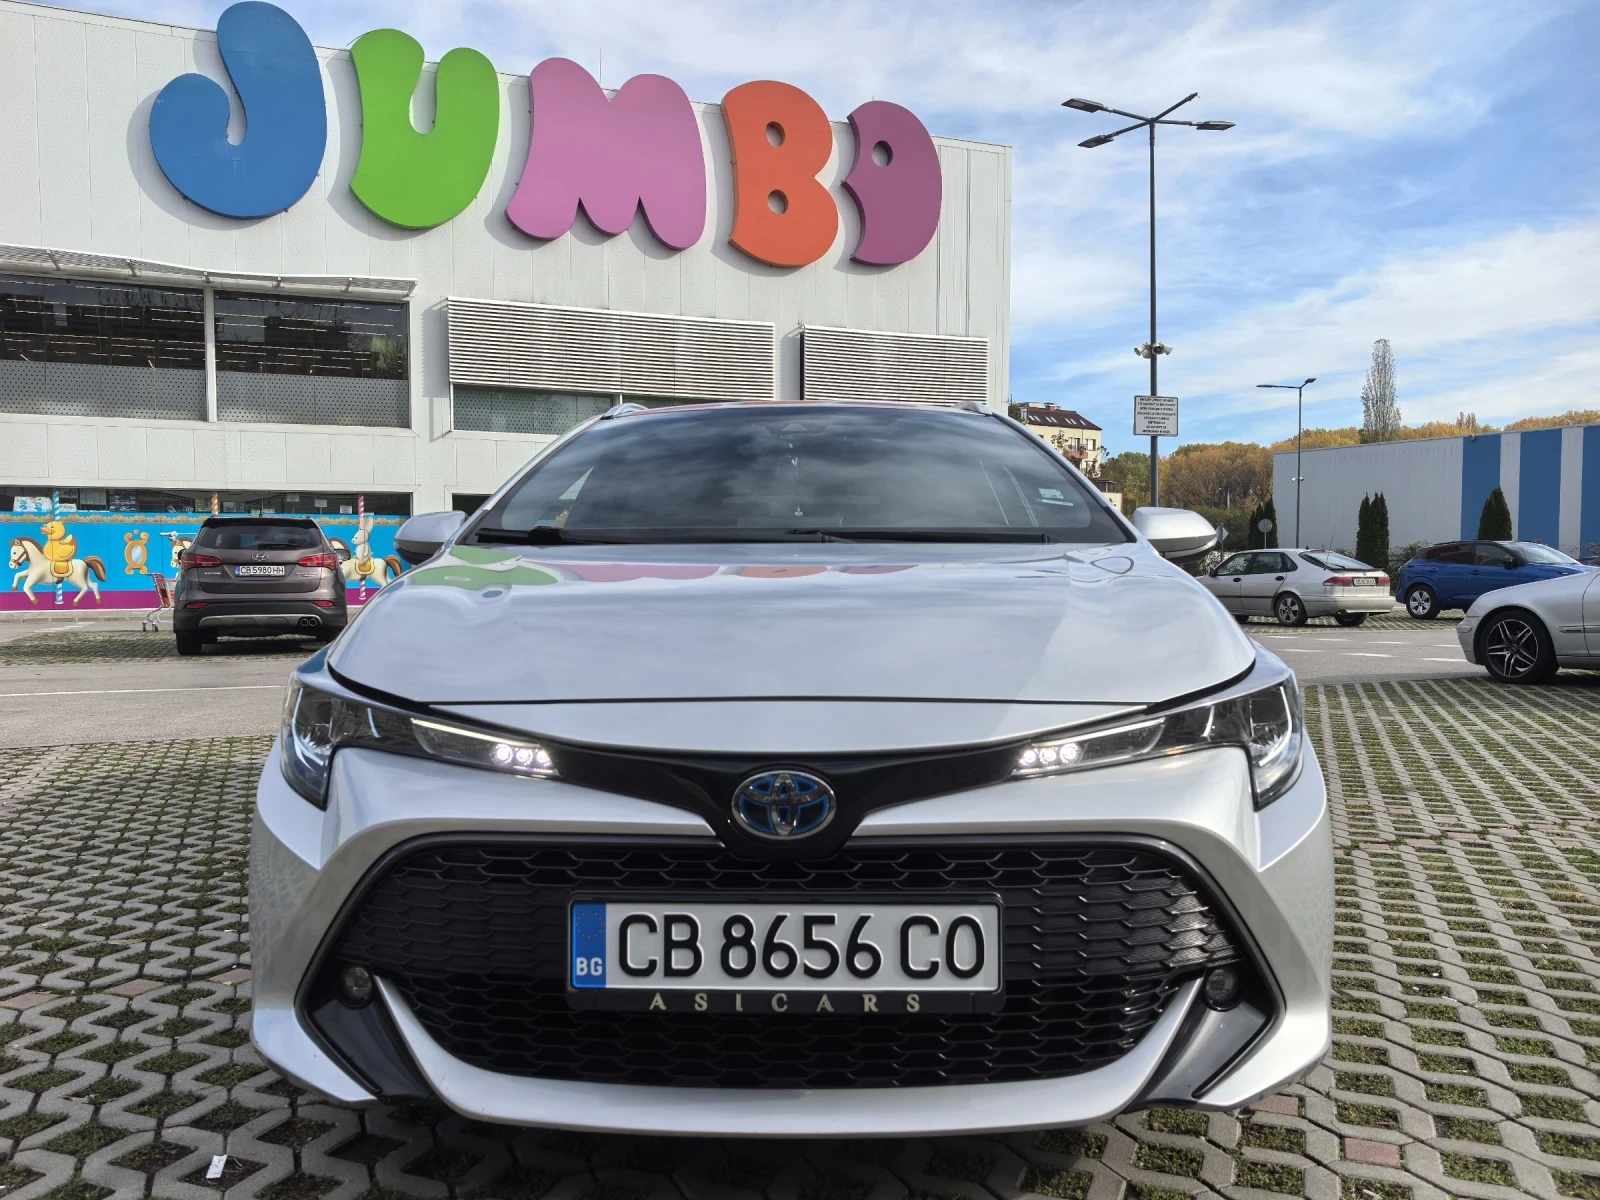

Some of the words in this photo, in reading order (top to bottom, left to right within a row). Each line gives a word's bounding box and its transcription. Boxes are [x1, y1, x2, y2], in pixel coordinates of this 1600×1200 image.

[150, 1, 942, 268] JUMBO
[253, 566, 271, 574] 5980
[618, 913, 703, 978] CB
[720, 914, 882, 979] 8656
[899, 914, 985, 980] CO
[576, 956, 603, 976] BG
[649, 993, 920, 1012] ASICARS
